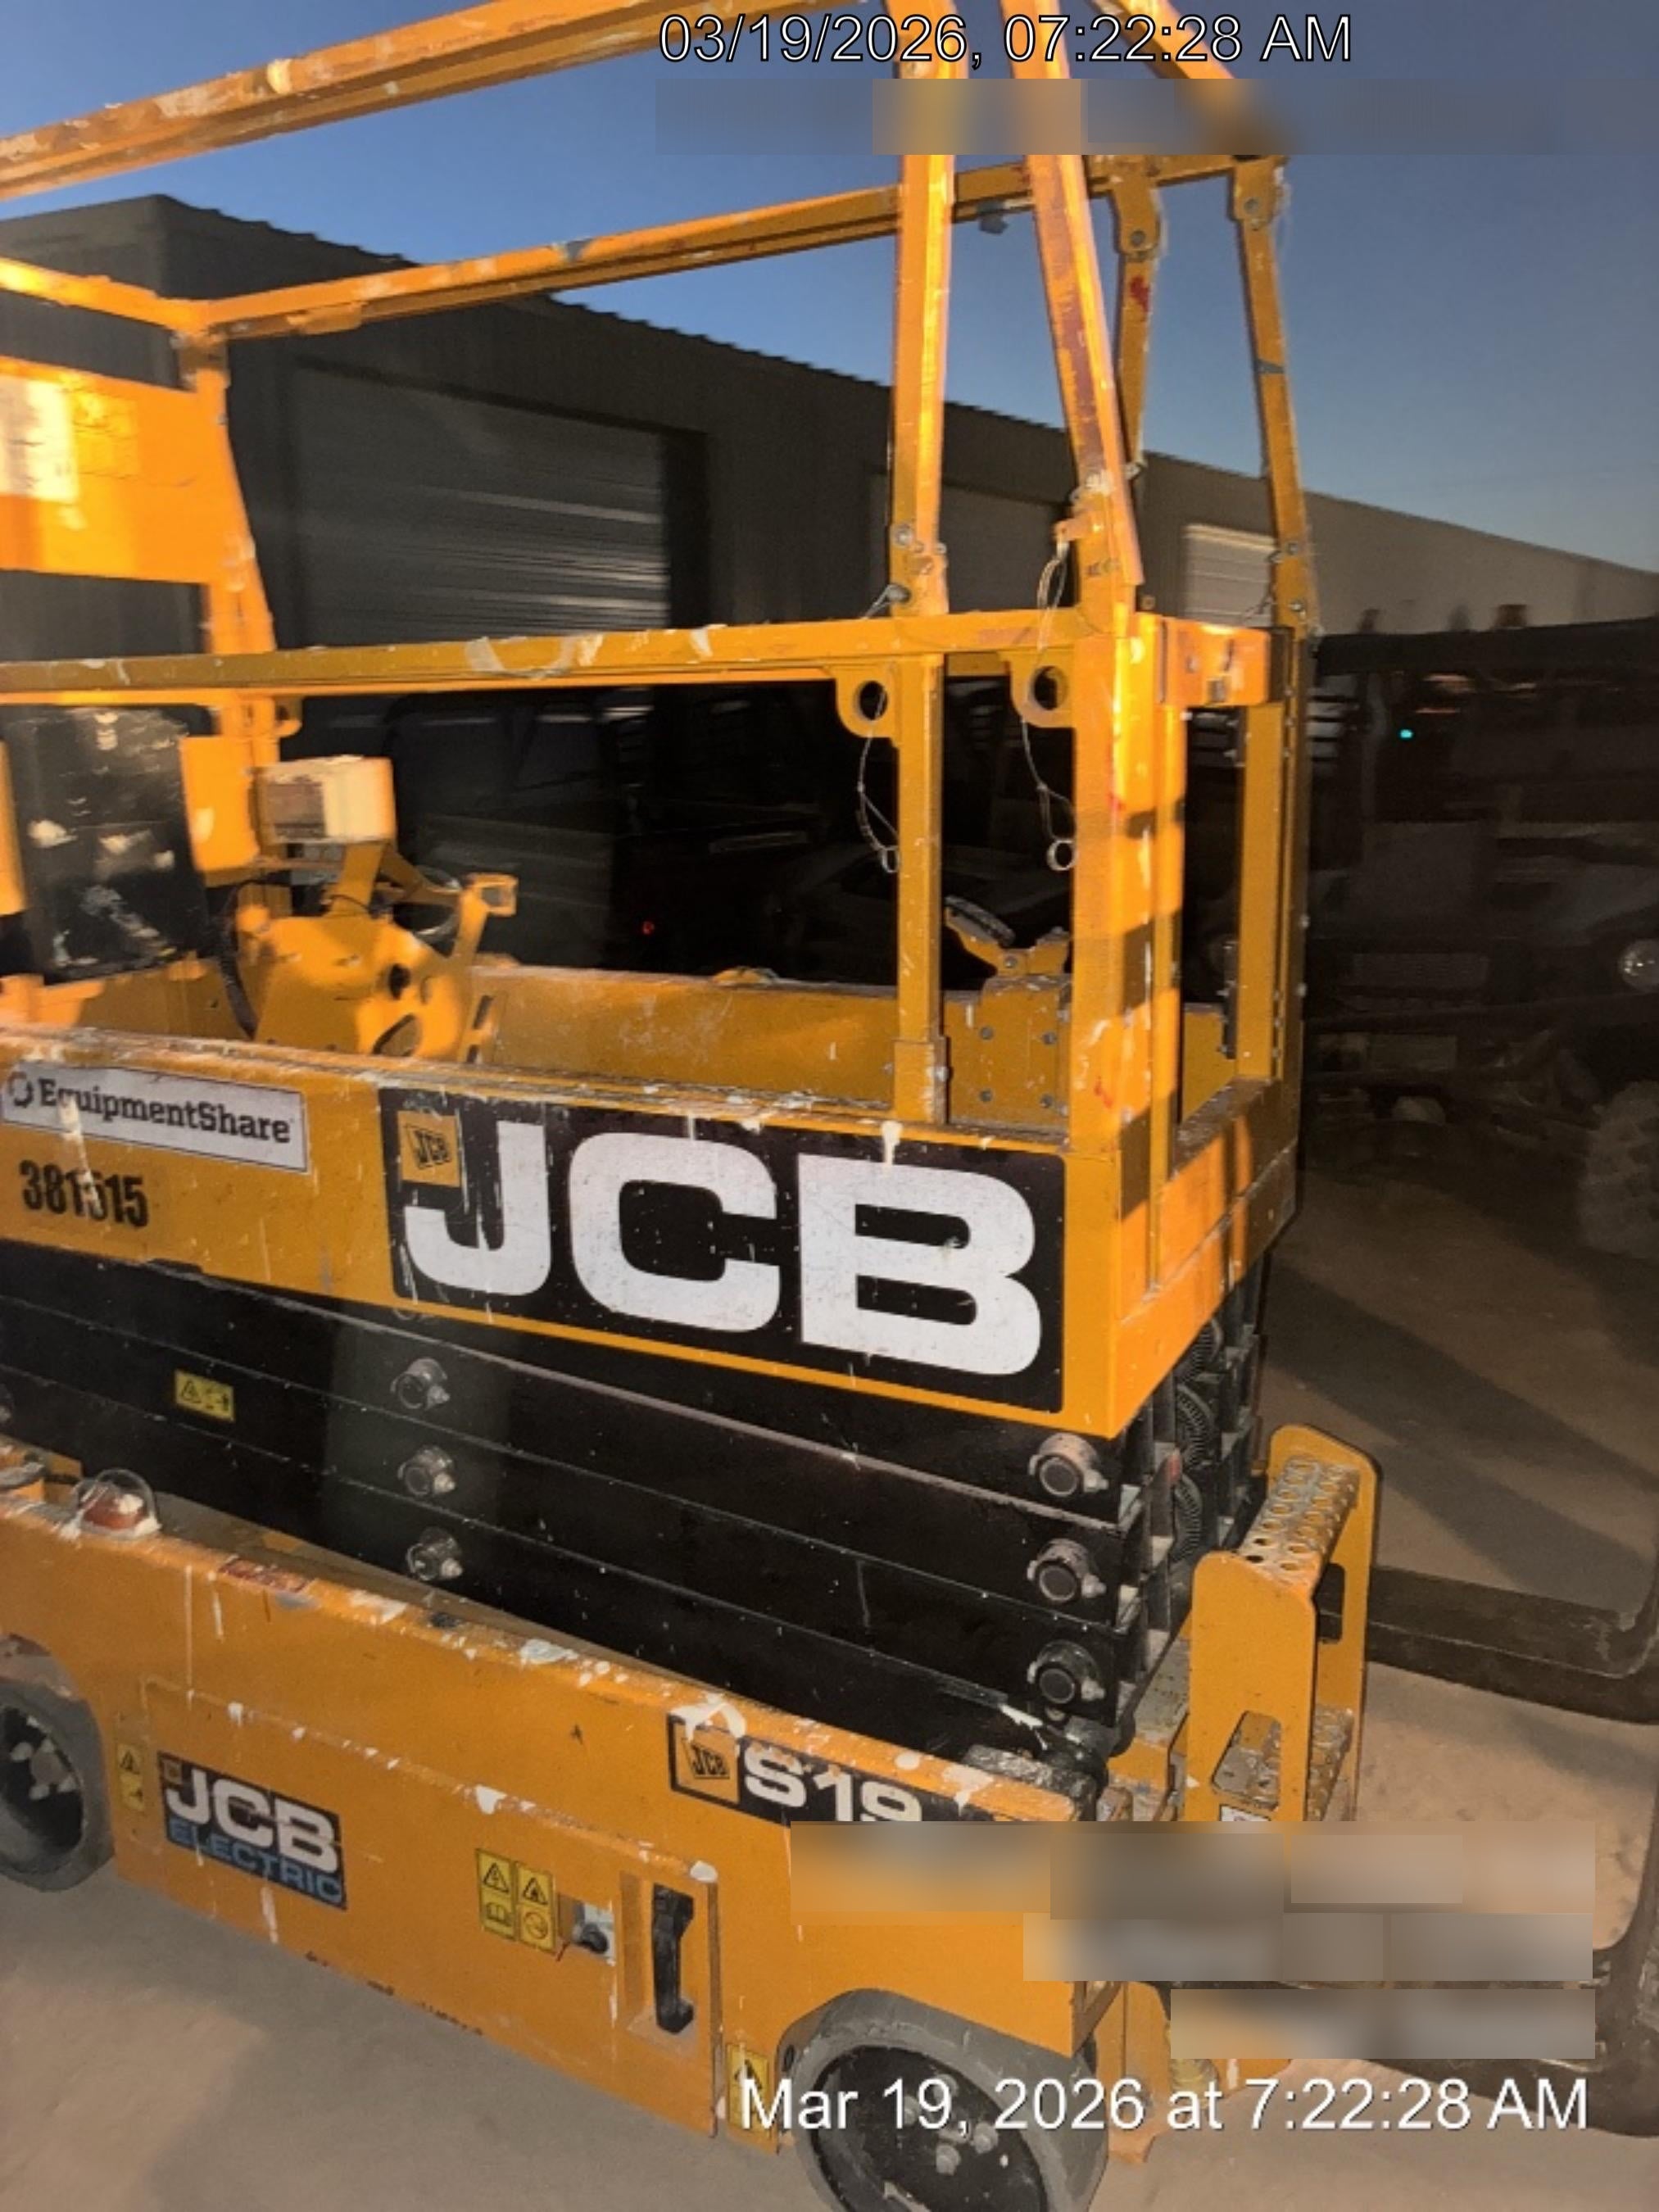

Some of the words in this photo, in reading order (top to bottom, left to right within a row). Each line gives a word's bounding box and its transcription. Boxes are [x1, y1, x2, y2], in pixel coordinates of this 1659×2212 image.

[405, 1120, 1042, 1376] JCB
[691, 1743, 728, 1777] JCB
[165, 1767, 338, 1873] JCB
[168, 1816, 344, 1904] ELECTRIC
